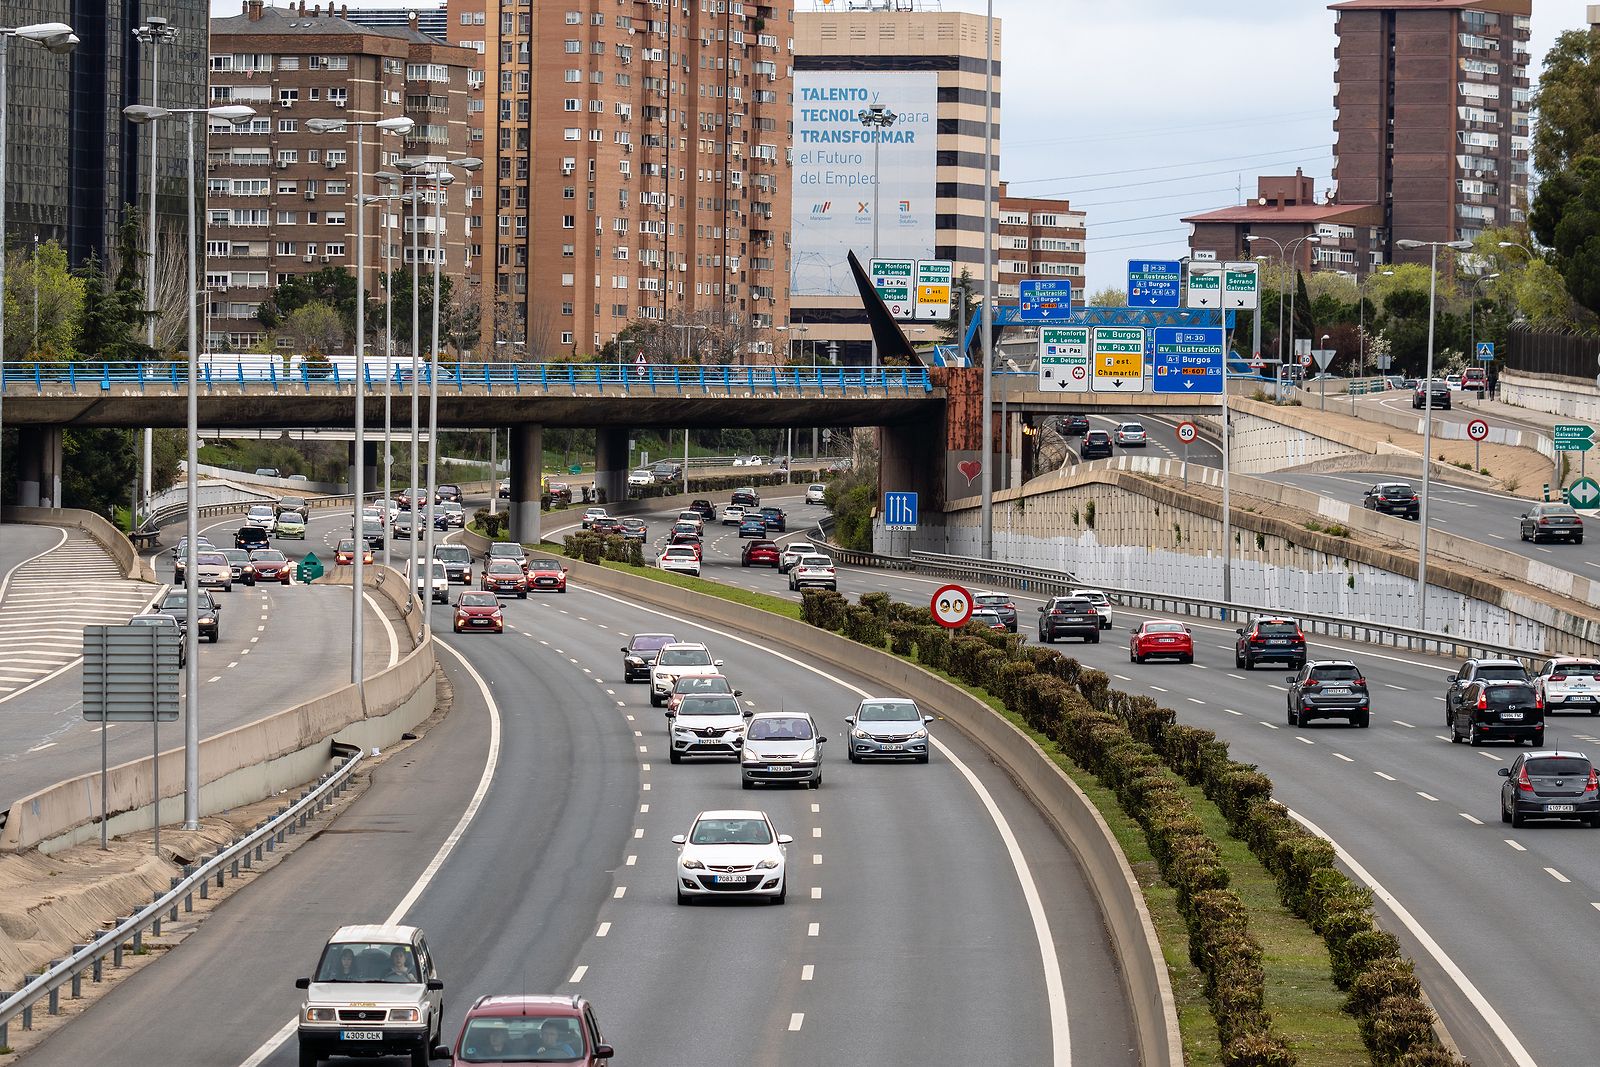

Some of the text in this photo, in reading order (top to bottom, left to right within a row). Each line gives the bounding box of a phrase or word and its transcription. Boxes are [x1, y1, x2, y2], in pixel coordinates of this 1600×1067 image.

[801, 88, 880, 103] TALENTO y
[801, 109, 929, 125] TECNOL para
[801, 130, 915, 143] TRANSFORMAR
[800, 151, 862, 164] el Futuro
[800, 171, 821, 185] del
[884, 293, 907, 301] Delgado
[1112, 330, 1141, 339] Burgos
[1175, 345, 1221, 353] Ilustración
[1182, 356, 1211, 365] Burgos
[1181, 428, 1193, 437] 50
[1471, 426, 1485, 434] 50
[939, 599, 965, 614] 90
[345, 1032, 365, 1040] 4309
